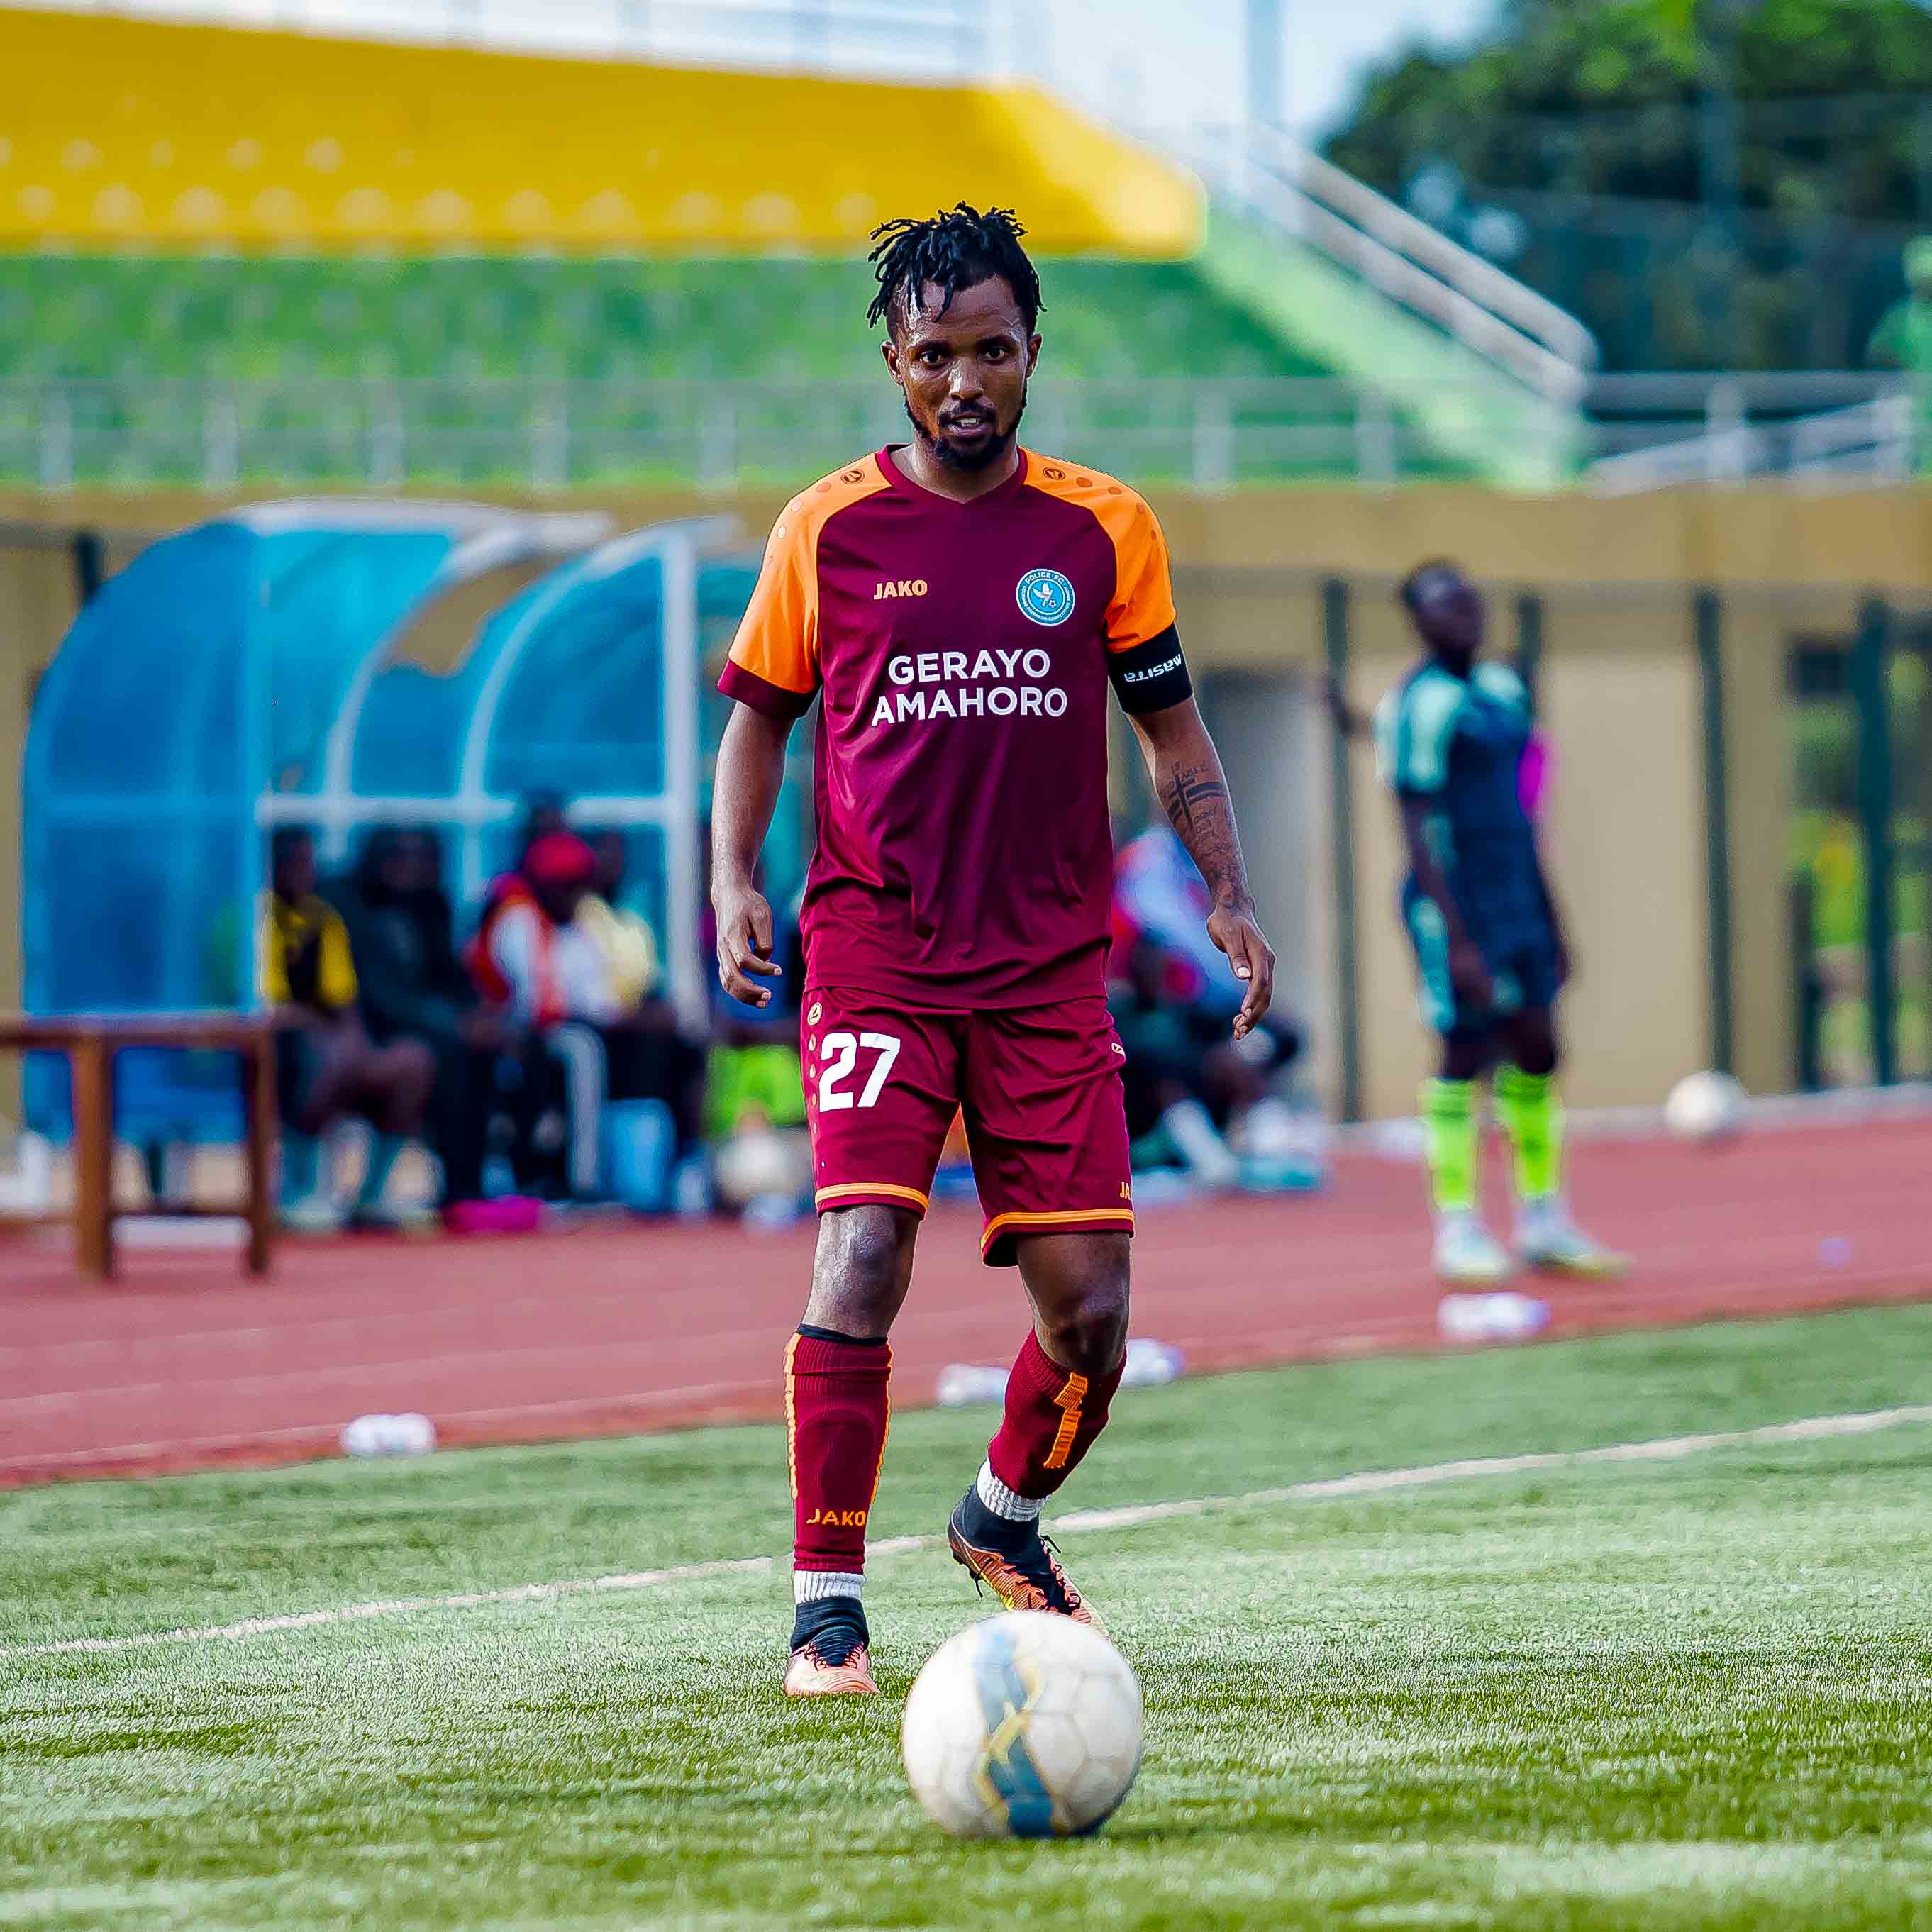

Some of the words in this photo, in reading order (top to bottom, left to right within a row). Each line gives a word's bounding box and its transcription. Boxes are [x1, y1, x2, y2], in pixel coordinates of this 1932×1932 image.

[1025, 572, 1051, 584] POLICE
[1053, 574, 1065, 584] FC
[873, 579, 928, 600] JAKO
[888, 648, 1050, 685] GERAYO
[871, 687, 1067, 727] AMAHORO
[818, 1032, 901, 1113] 27
[1119, 1181, 1131, 1201] JA
[806, 1509, 866, 1526] JAKO
